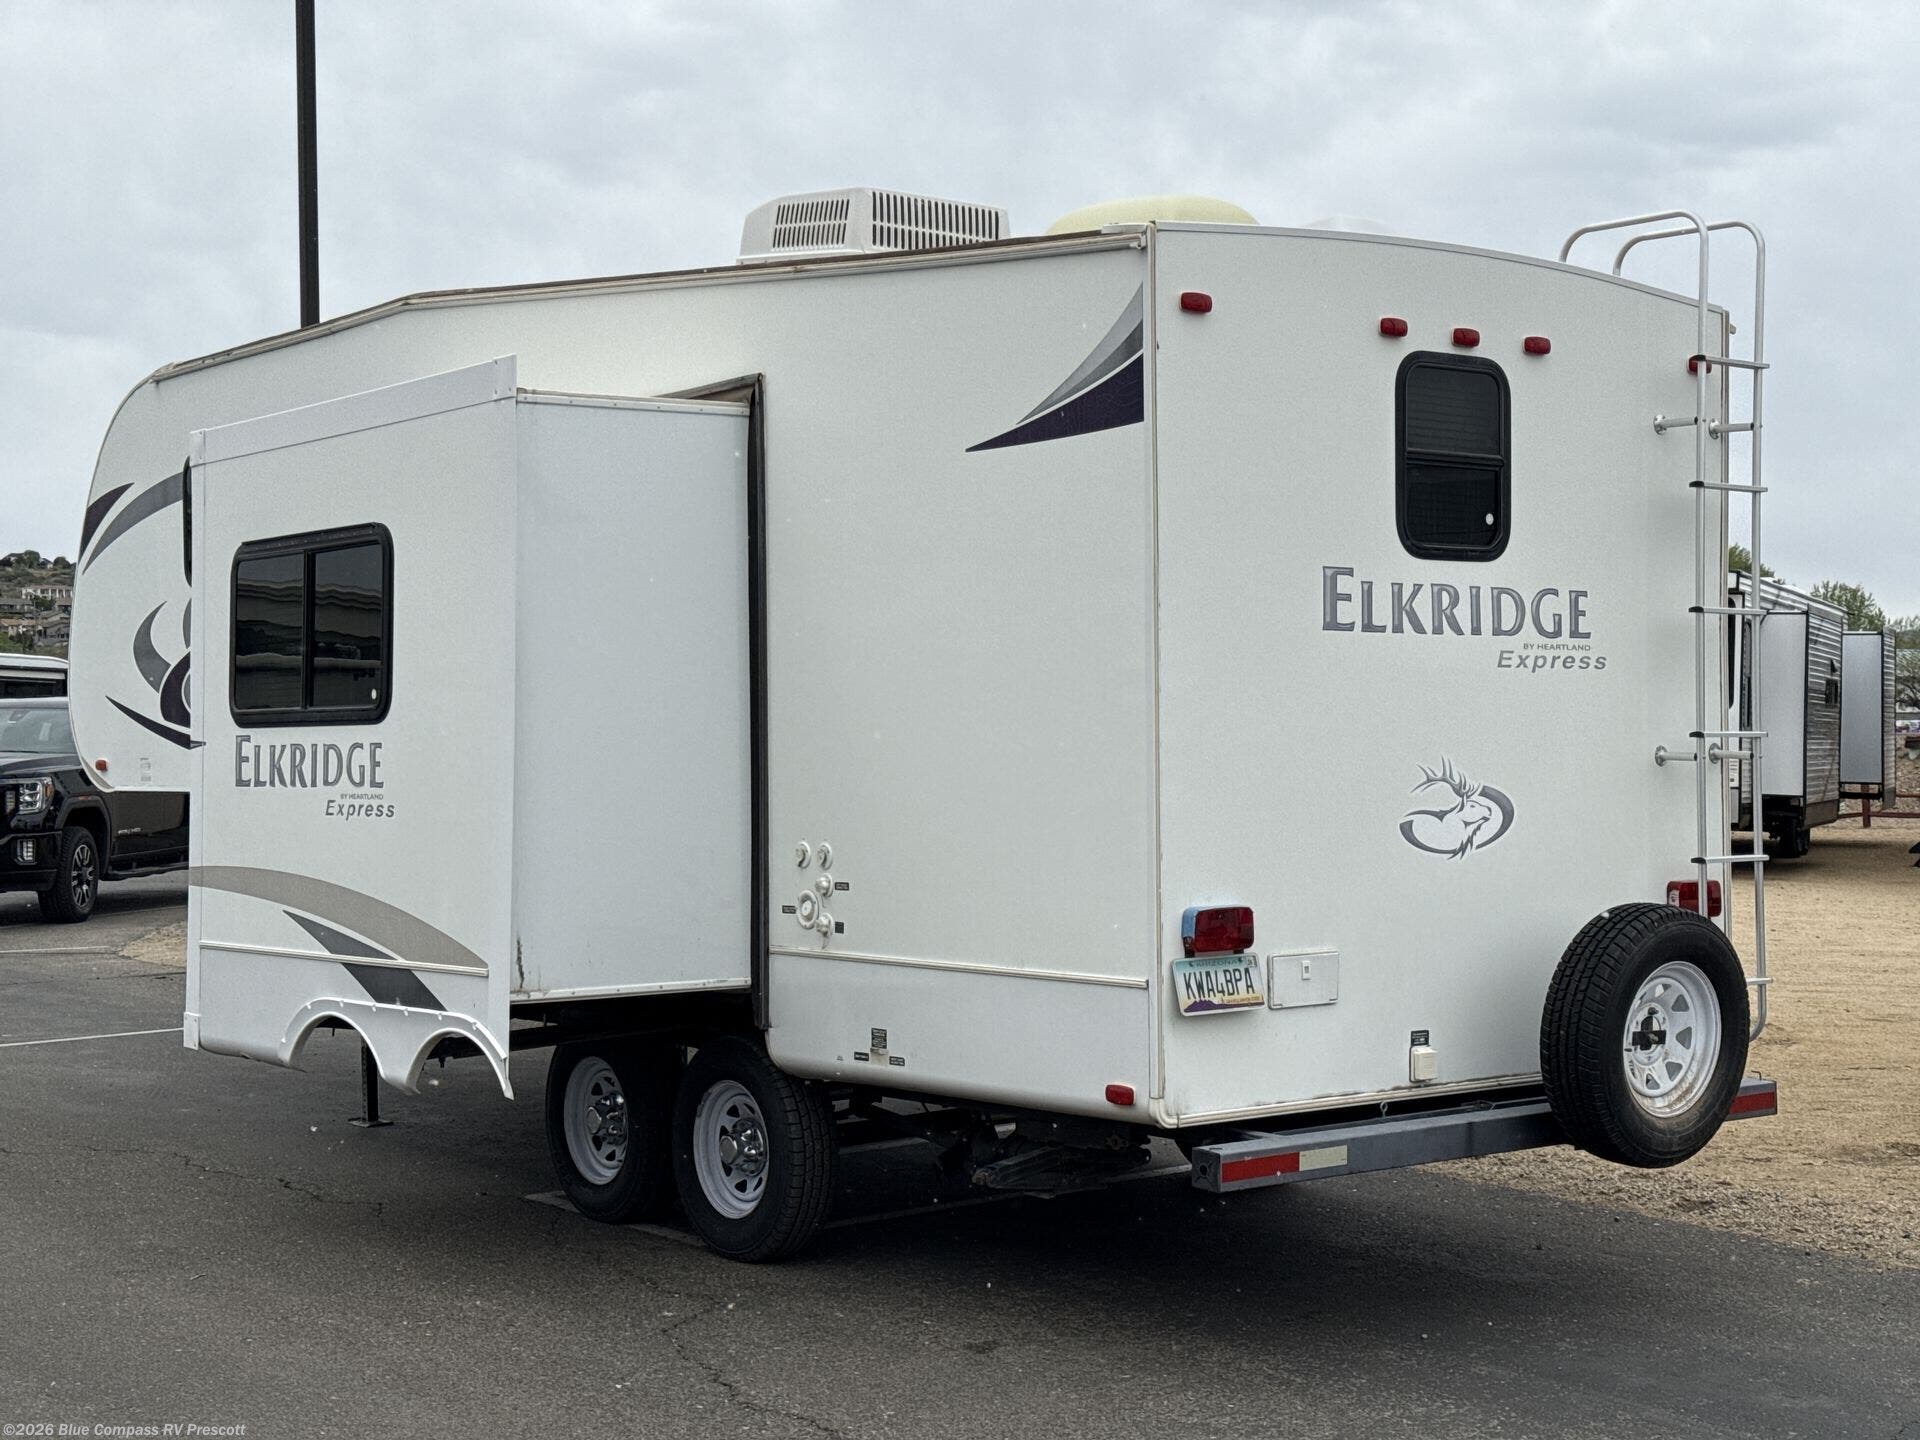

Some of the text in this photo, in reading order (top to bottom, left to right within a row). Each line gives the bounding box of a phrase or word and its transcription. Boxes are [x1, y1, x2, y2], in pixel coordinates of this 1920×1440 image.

[1322, 565, 1592, 640] ELKRIDGE
[1523, 643, 1591, 652] BY HEARTLAND
[1497, 650, 1608, 673] Express
[235, 734, 384, 789] ELKRIDGE
[349, 793, 384, 801] HEARTLAND
[325, 799, 395, 821] Express
[1183, 967, 1256, 1000] KWA4BPA
